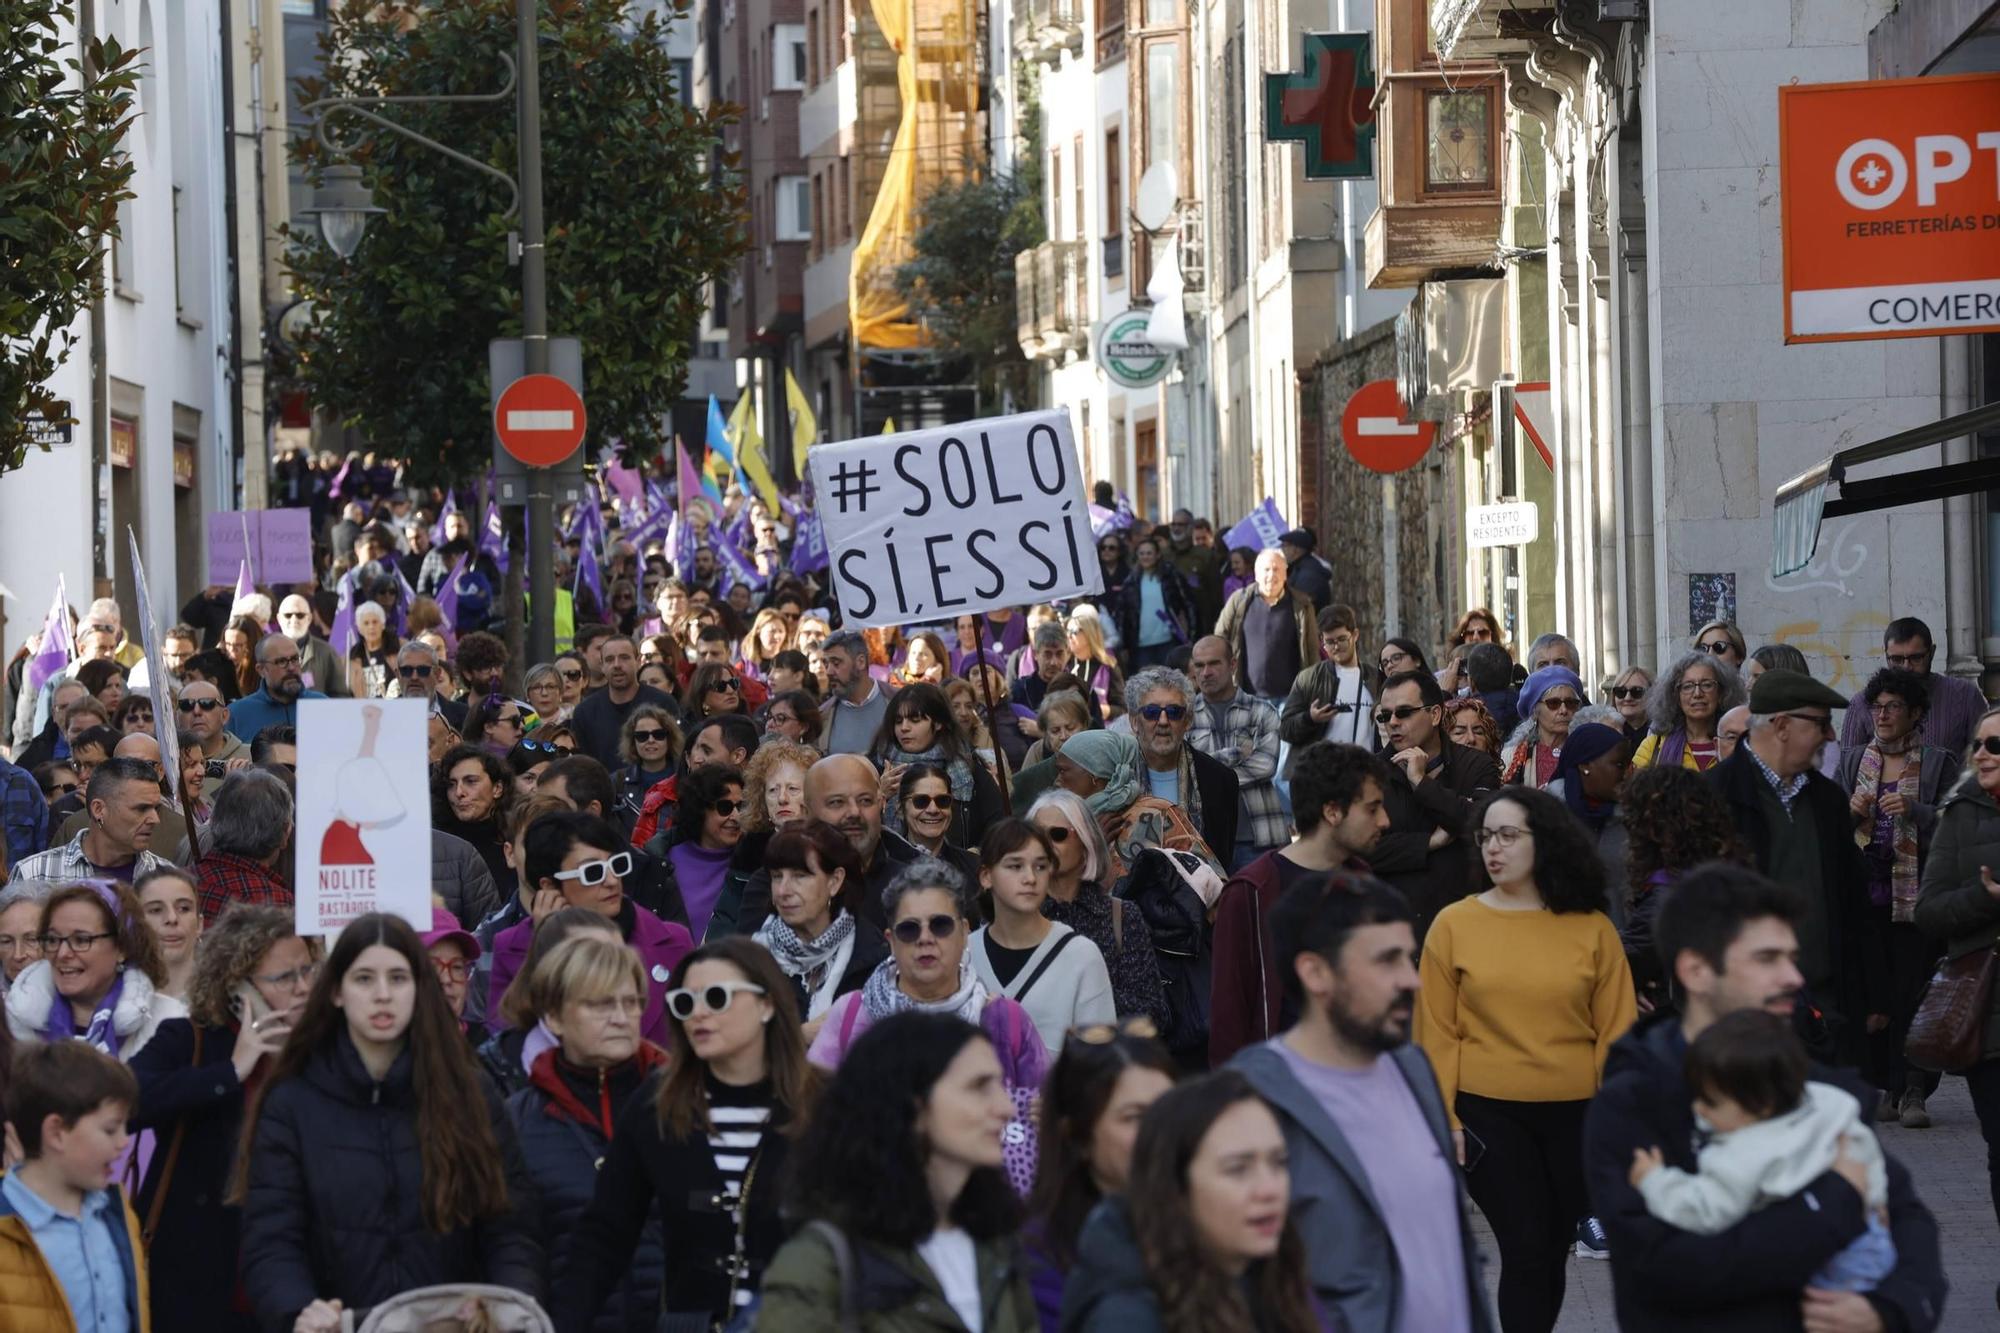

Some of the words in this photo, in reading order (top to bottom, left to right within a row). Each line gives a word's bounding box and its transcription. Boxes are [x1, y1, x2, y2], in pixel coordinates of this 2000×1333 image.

[1846, 214, 1977, 237] FERRETERÍAS
[1869, 293, 2000, 325] COMER
[829, 424, 1066, 516] #SOLO
[1479, 510, 1520, 525] EXCEPTO
[1473, 524, 1527, 540] RESIDENTES
[318, 868, 376, 890] NOLITE
